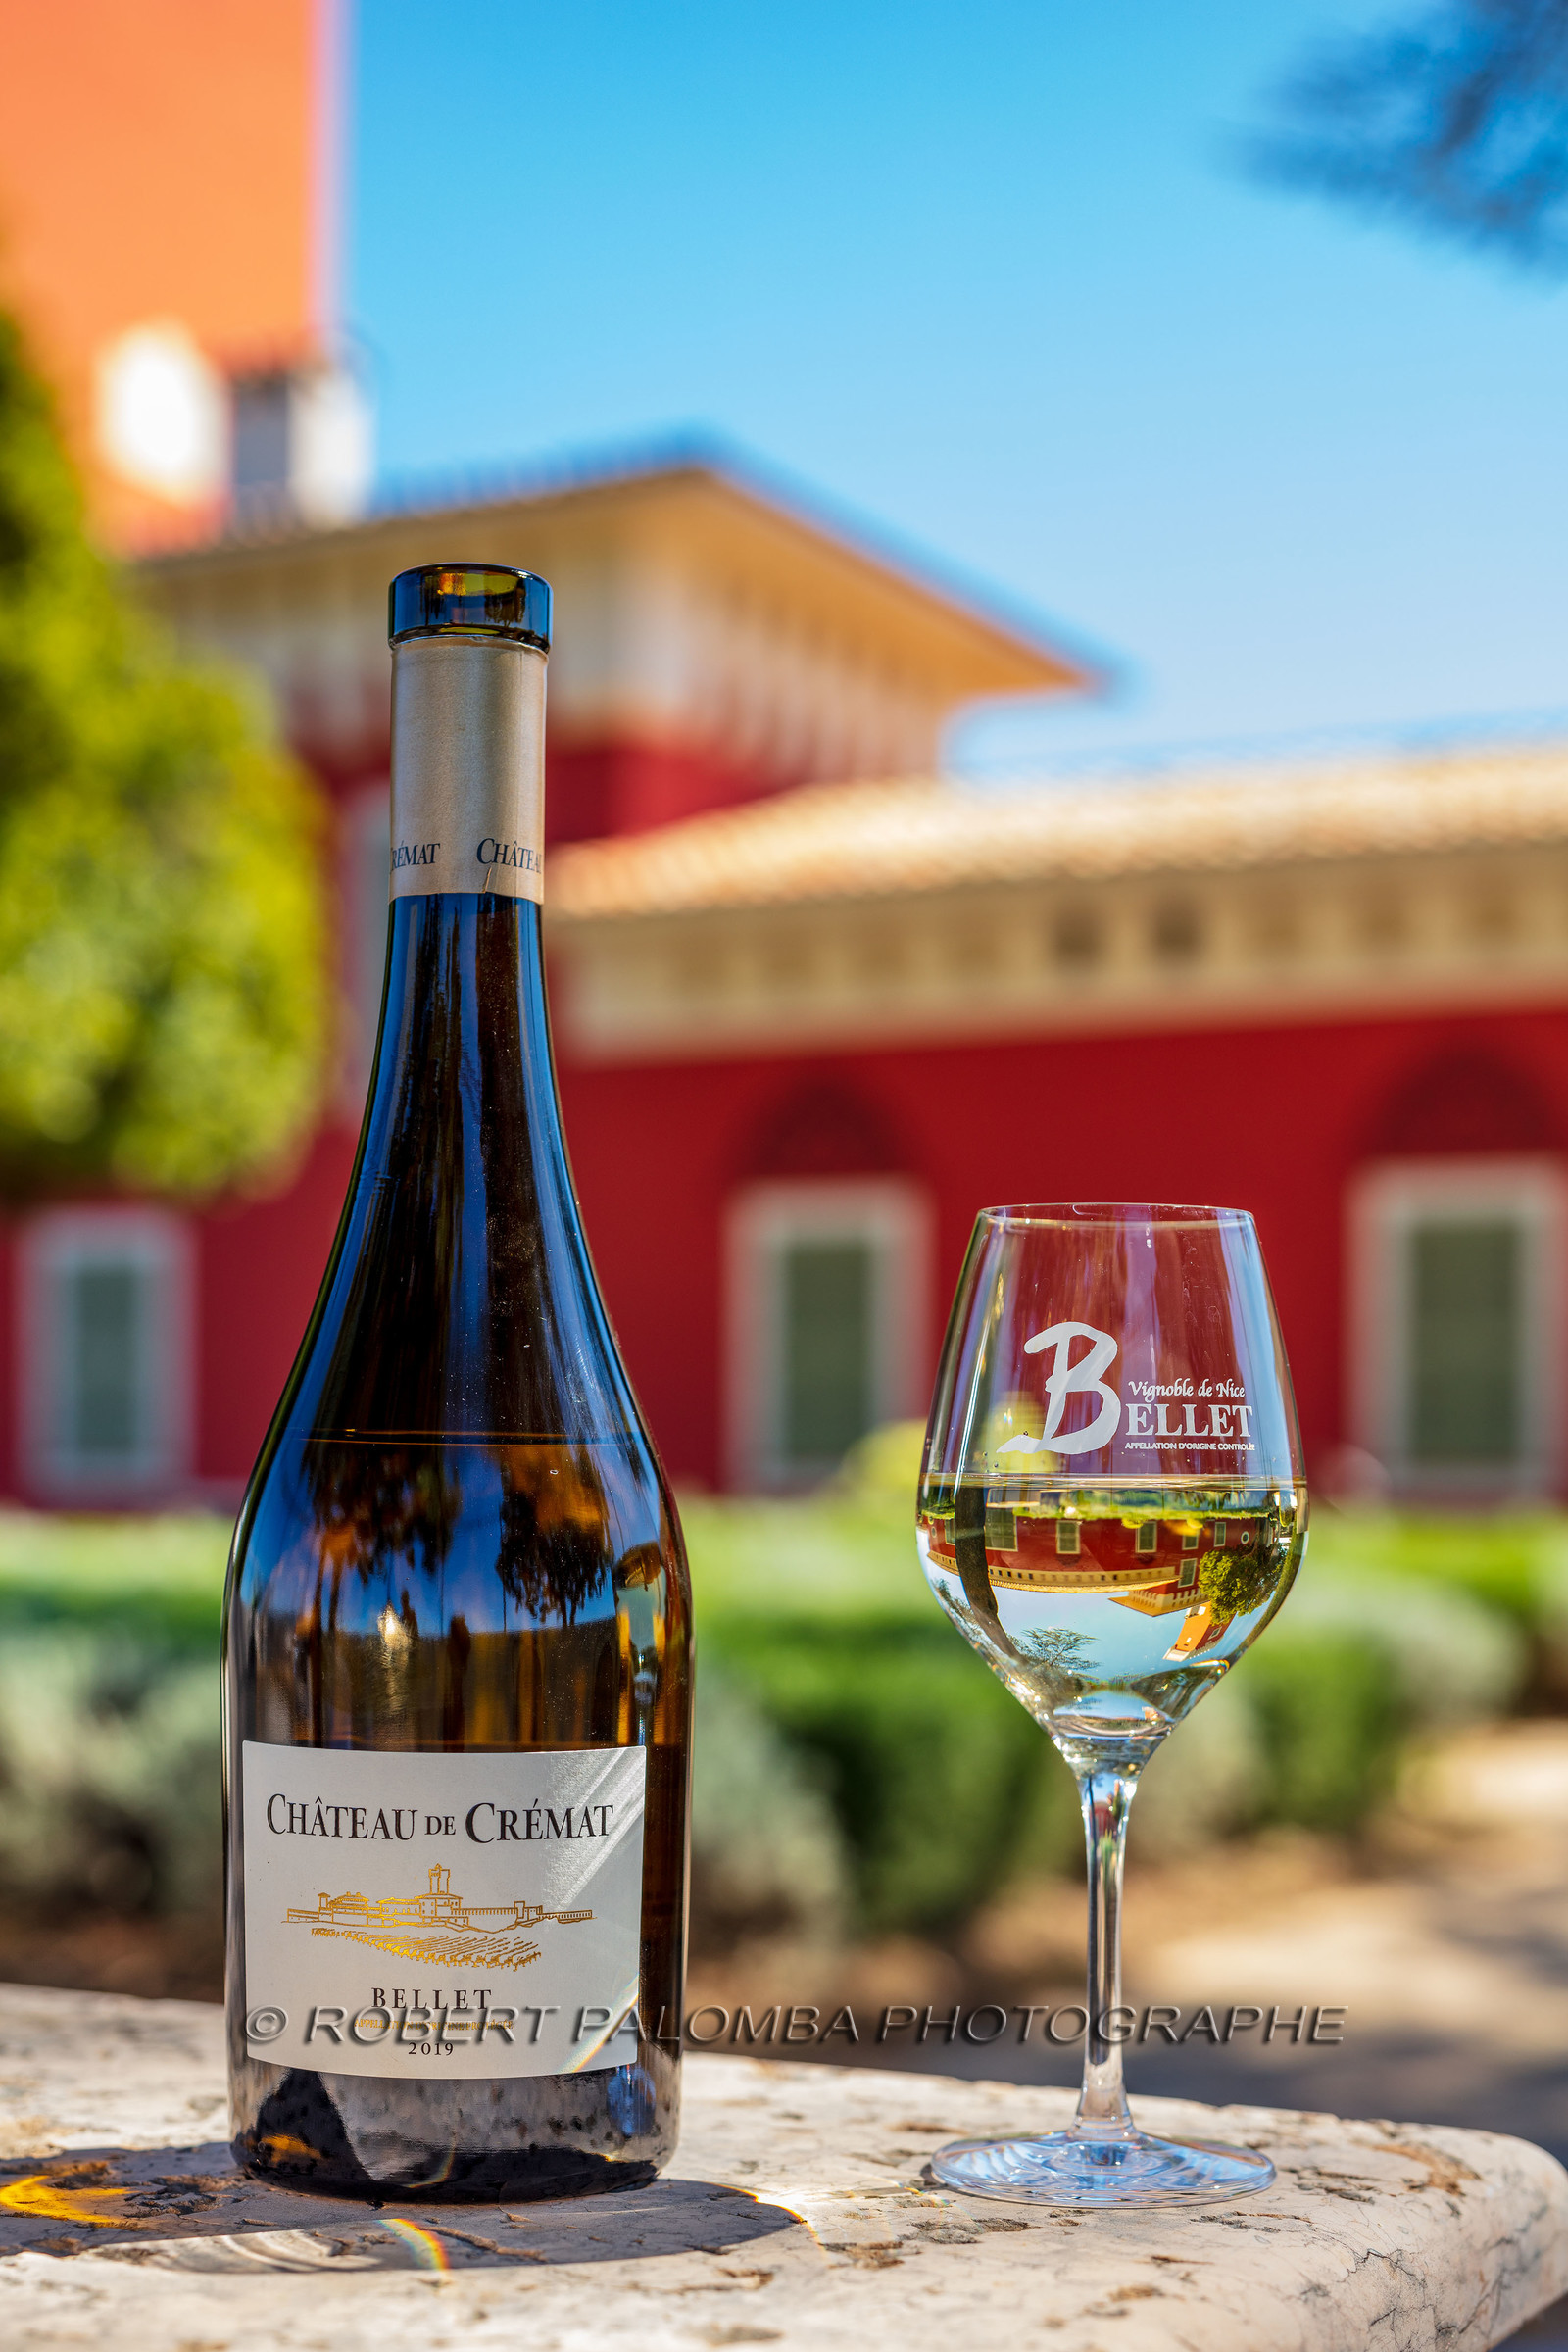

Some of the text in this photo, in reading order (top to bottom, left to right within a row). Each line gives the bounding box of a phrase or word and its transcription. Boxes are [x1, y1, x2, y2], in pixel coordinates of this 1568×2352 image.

[391, 840, 440, 871] RÉMAT
[1128, 1378, 1246, 1402] Vignoble de Nice
[1125, 1442, 1176, 1450] APPELLATION
[266, 1792, 614, 1844] CHÂTEAU DE CRÉMAT
[371, 1986, 492, 2009] BELLET
[408, 2042, 454, 2056] 2019
